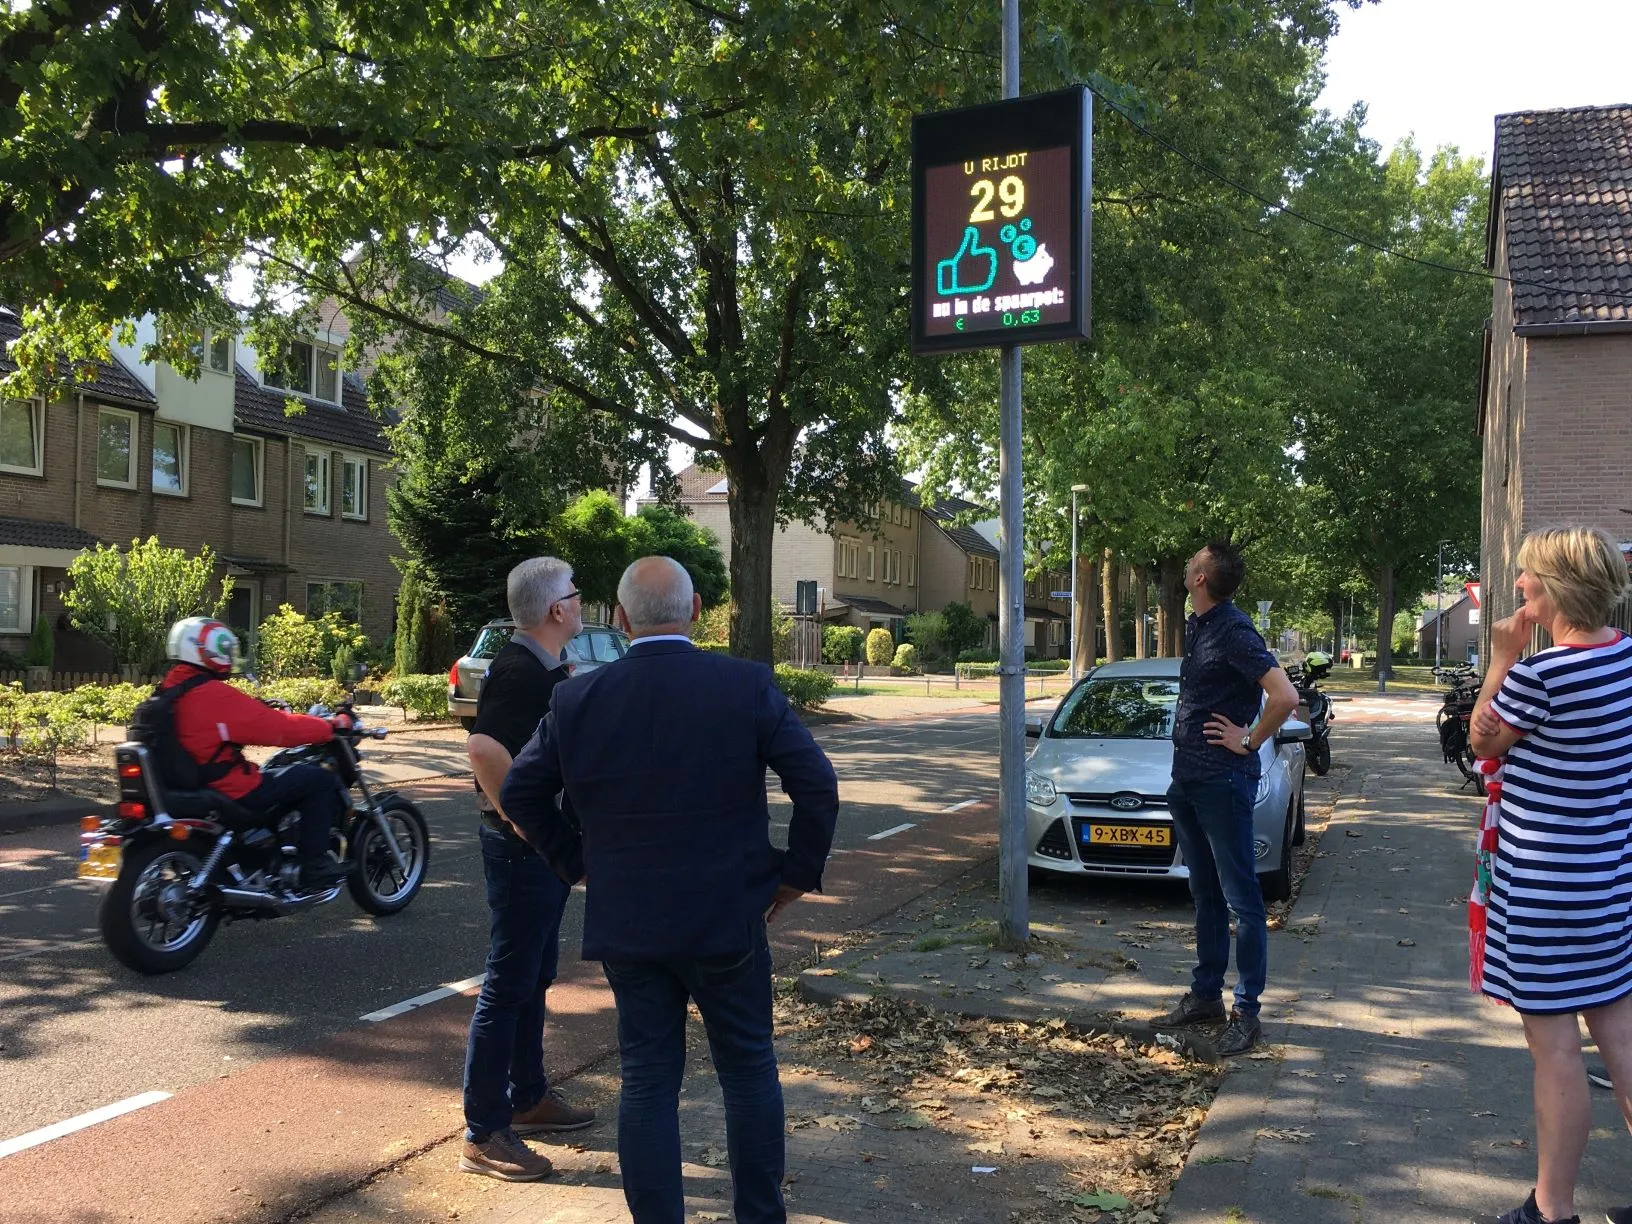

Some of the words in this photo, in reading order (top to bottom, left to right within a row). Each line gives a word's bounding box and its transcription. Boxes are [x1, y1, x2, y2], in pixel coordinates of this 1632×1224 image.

[964, 161, 974, 174] U
[982, 152, 1028, 173] RIJDT
[969, 175, 1025, 223] 29
[972, 295, 990, 314] de
[956, 318, 964, 330] €
[1003, 310, 1040, 326] 0,63
[1094, 827, 1165, 843] 9-XBX-45
